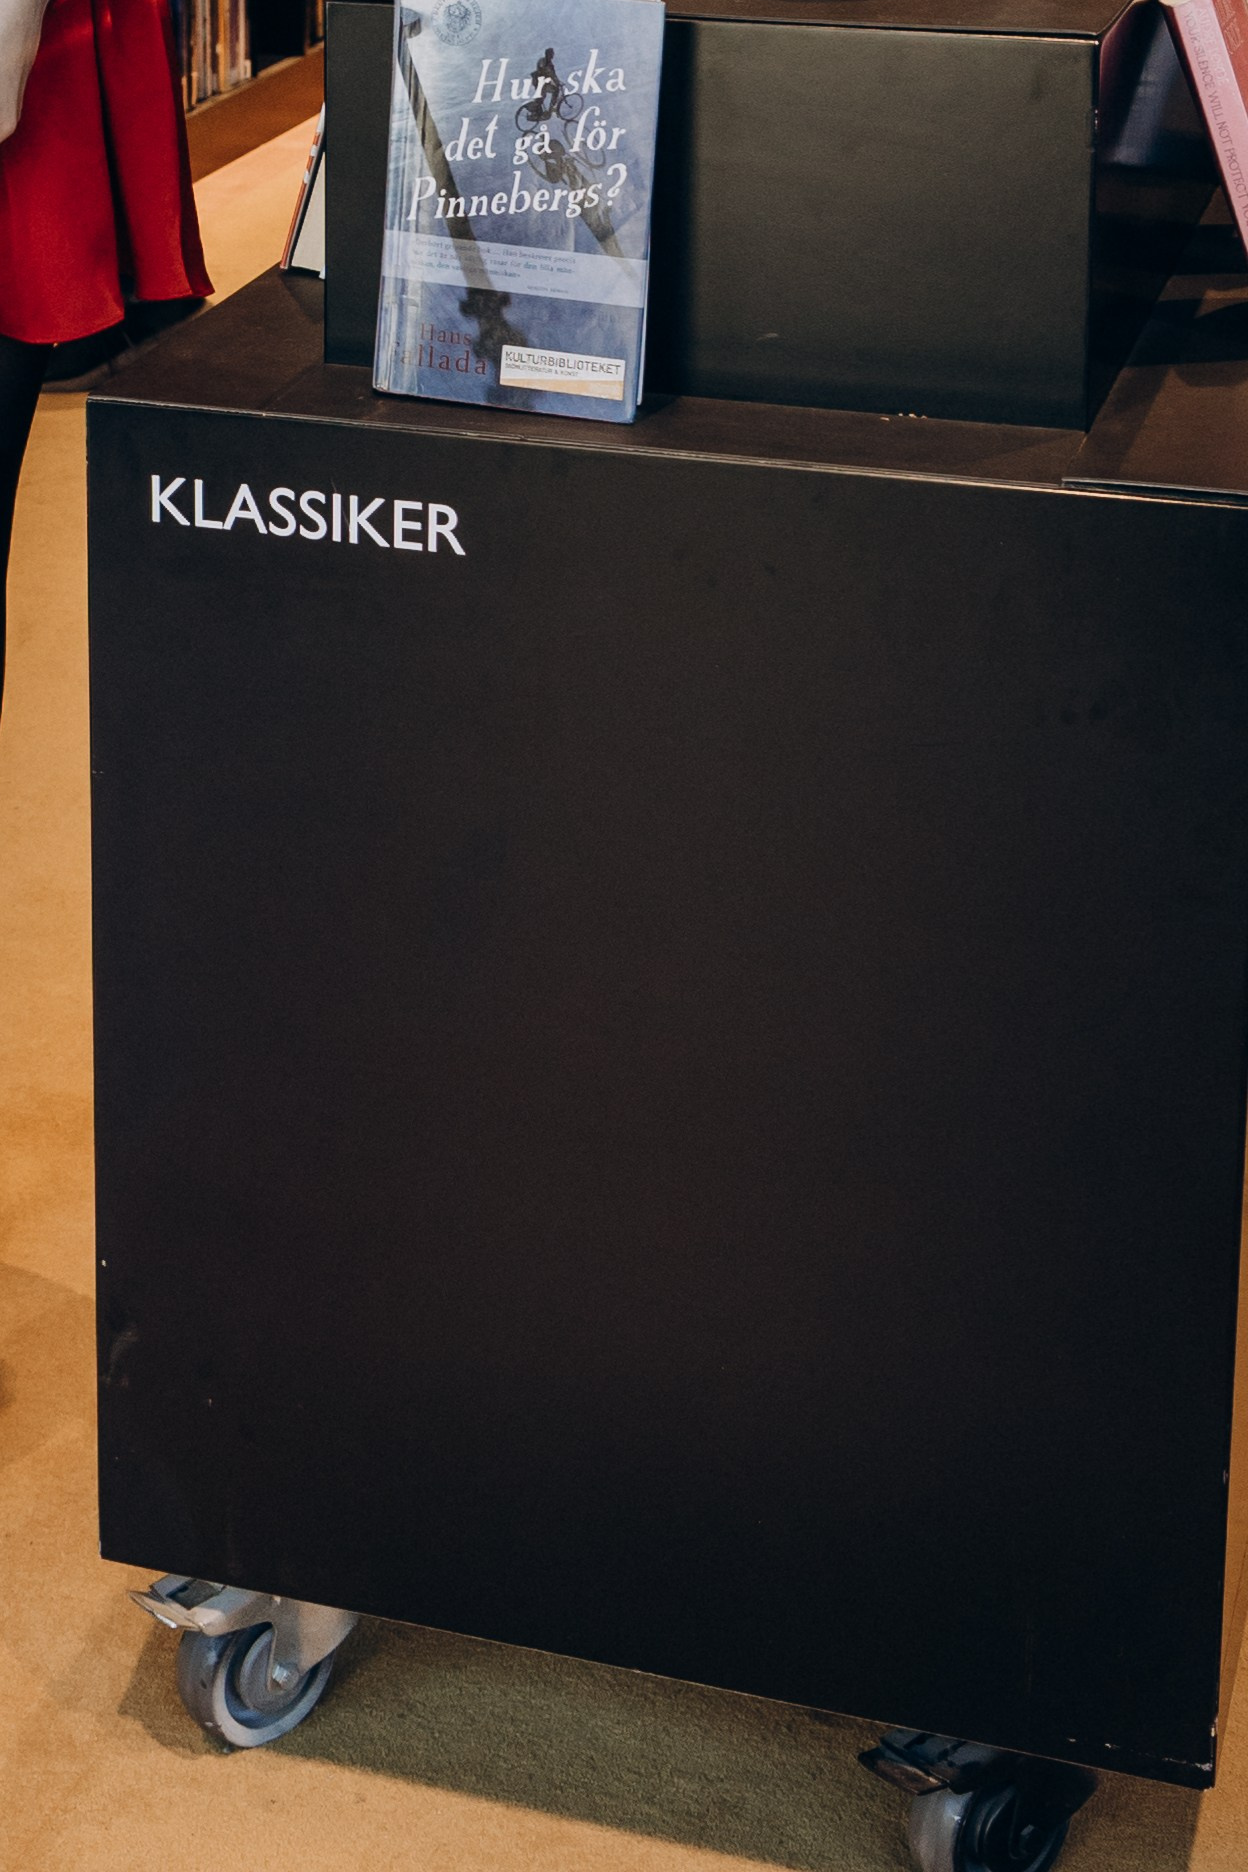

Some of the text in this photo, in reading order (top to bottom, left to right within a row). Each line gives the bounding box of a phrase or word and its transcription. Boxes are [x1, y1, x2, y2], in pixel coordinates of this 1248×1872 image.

[1184, 11, 1200, 44] YOUR
[472, 47, 628, 104] Hur ska
[1194, 45, 1214, 91] SILENCE
[1207, 91, 1225, 121] WILL
[444, 106, 628, 165] det gå för
[1216, 120, 1233, 147] NOT
[405, 164, 629, 223] Pinnebergs?
[1224, 147, 1248, 200] PROTECT
[419, 322, 473, 346] Hans
[504, 350, 623, 376] KULTURBIBLIOTEKET
[152, 475, 466, 556] KLASSIKER
